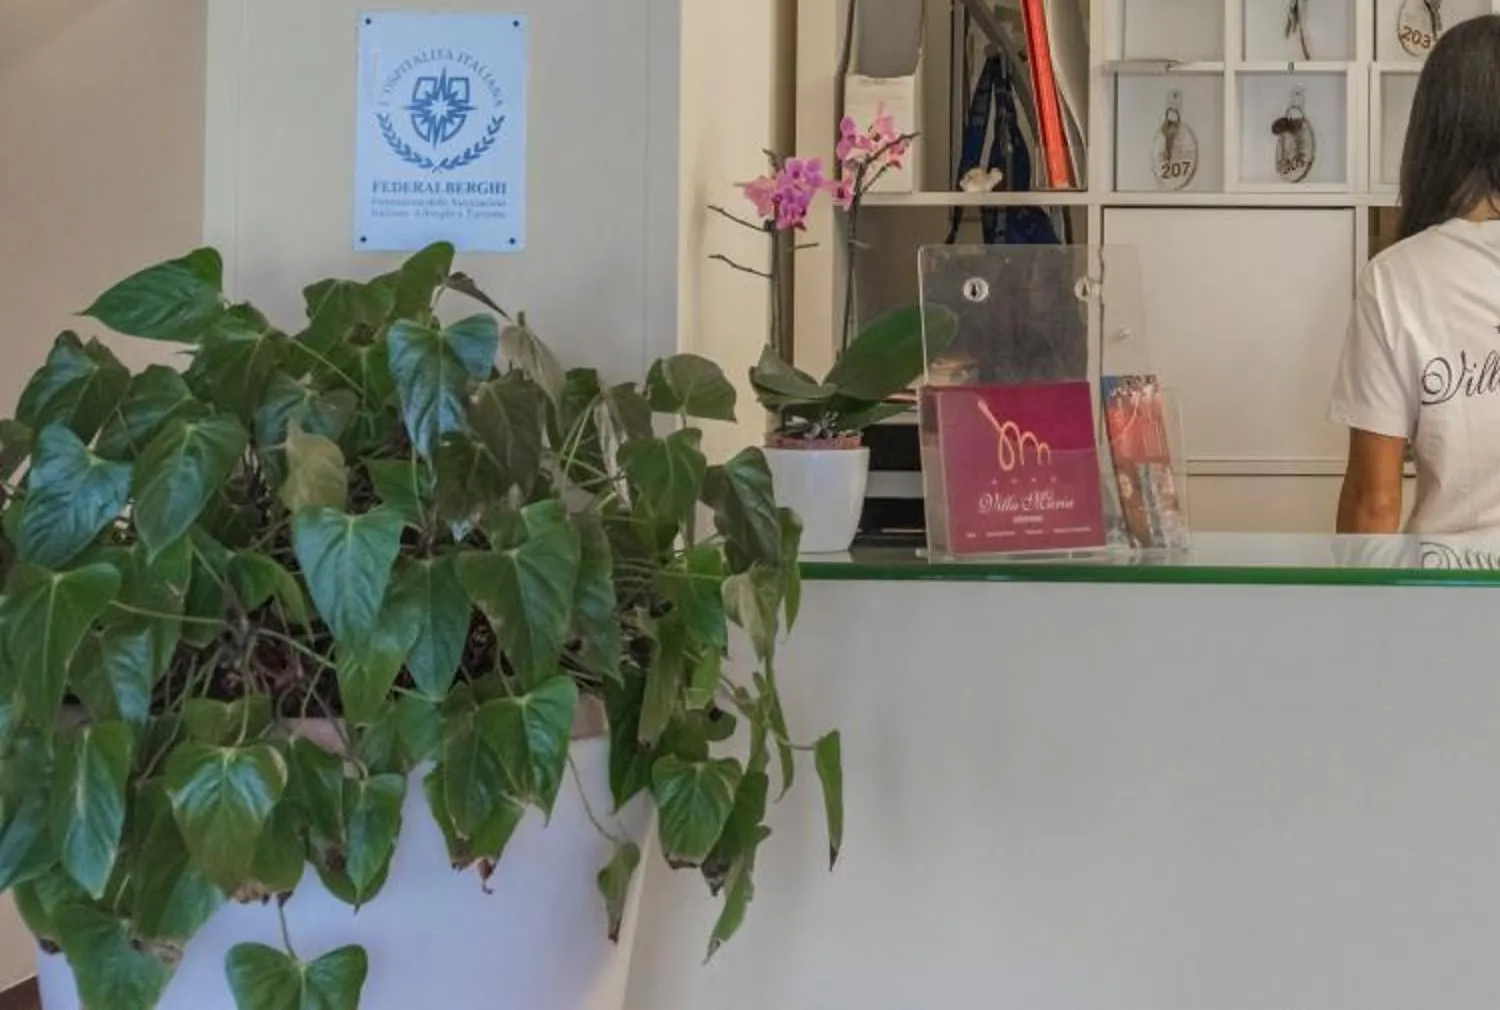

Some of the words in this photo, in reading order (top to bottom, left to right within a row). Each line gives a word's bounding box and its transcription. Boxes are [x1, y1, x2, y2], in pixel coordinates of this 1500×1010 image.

[1401, 25, 1432, 49] 203
[1160, 161, 1192, 180] 207
[978, 492, 1019, 513] Villa
[1021, 488, 1075, 511] Maria
